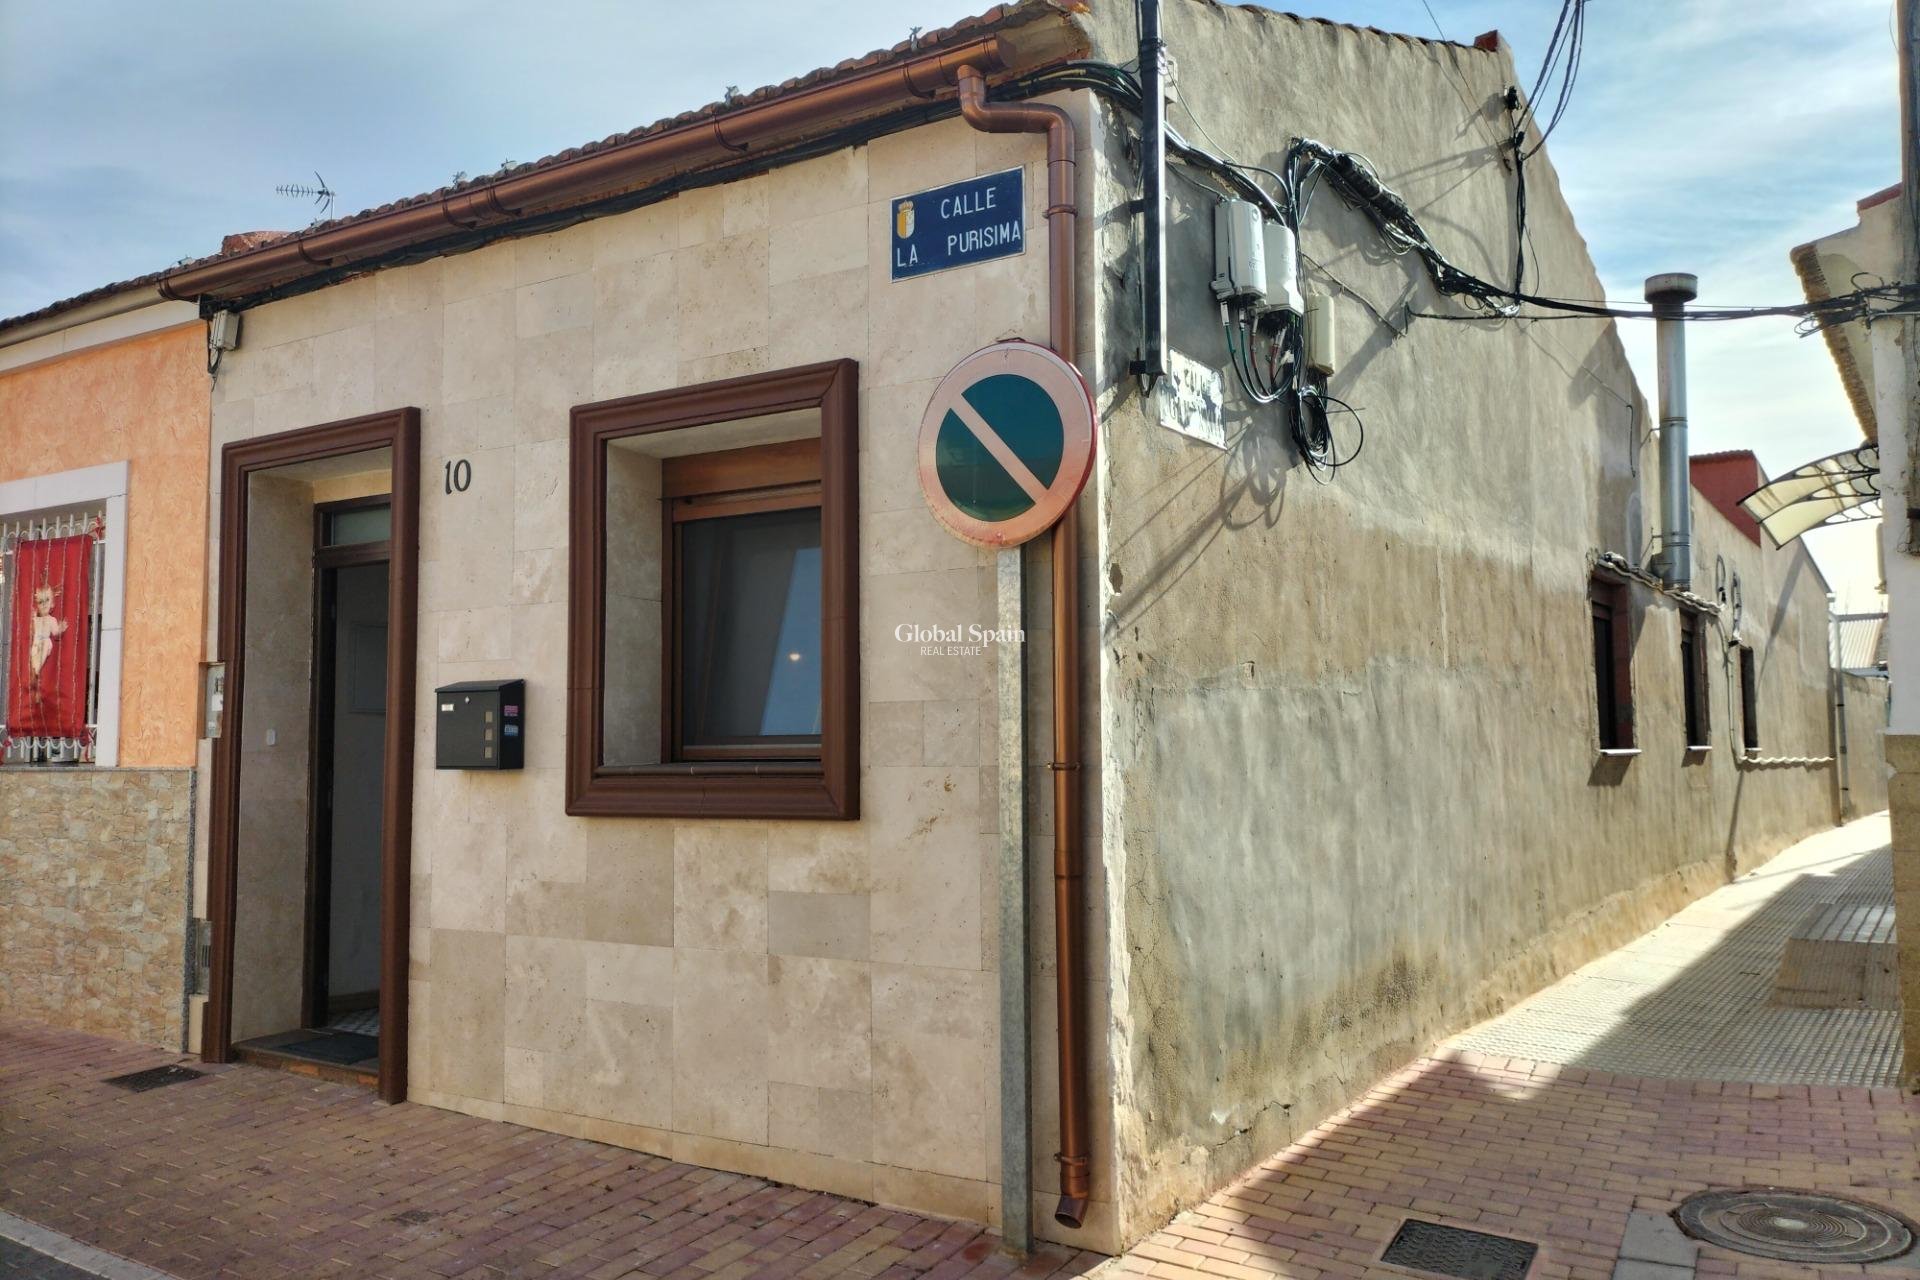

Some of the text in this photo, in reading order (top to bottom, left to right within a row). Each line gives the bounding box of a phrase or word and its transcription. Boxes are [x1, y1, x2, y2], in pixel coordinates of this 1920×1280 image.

[940, 187, 997, 219] CALLE
[896, 220, 1022, 267] LA PURISIMA
[445, 459, 472, 495] 10
